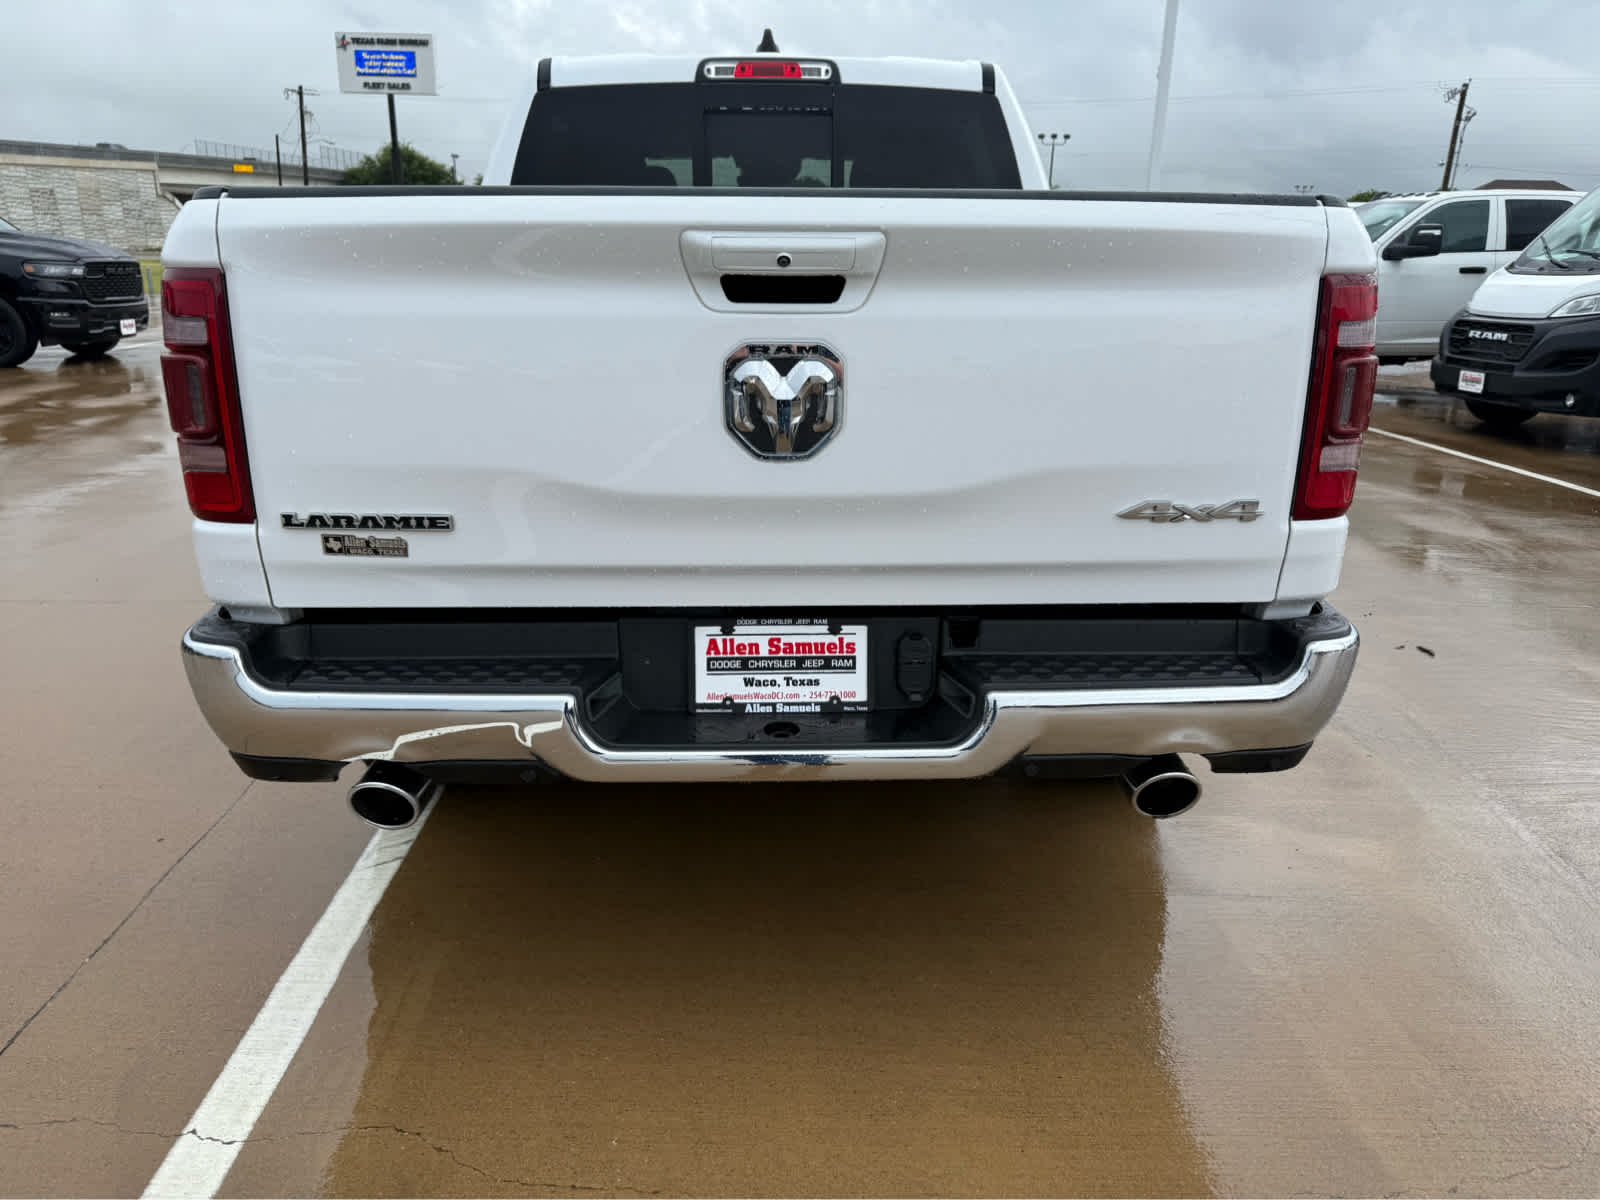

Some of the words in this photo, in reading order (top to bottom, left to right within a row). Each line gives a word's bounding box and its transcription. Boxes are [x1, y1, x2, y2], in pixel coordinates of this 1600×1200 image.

[351, 37, 375, 46] TEXAS
[363, 82, 385, 90] FLEET
[387, 82, 411, 91] SALES
[1468, 330, 1508, 341] RAM
[748, 345, 819, 355] RAM
[1115, 499, 1264, 523] 4x4
[281, 513, 453, 531] LARAMIE
[706, 638, 760, 656] Allen
[768, 637, 856, 656] Samuels
[710, 660, 742, 669] DODGE
[748, 660, 796, 669] CHRYSLER
[802, 659, 825, 668] JEEP
[831, 659, 853, 668] RAM
[743, 677, 781, 688] Waco,
[783, 677, 820, 687] Texas
[745, 704, 773, 713] Allen
[776, 703, 821, 713] Samuels
